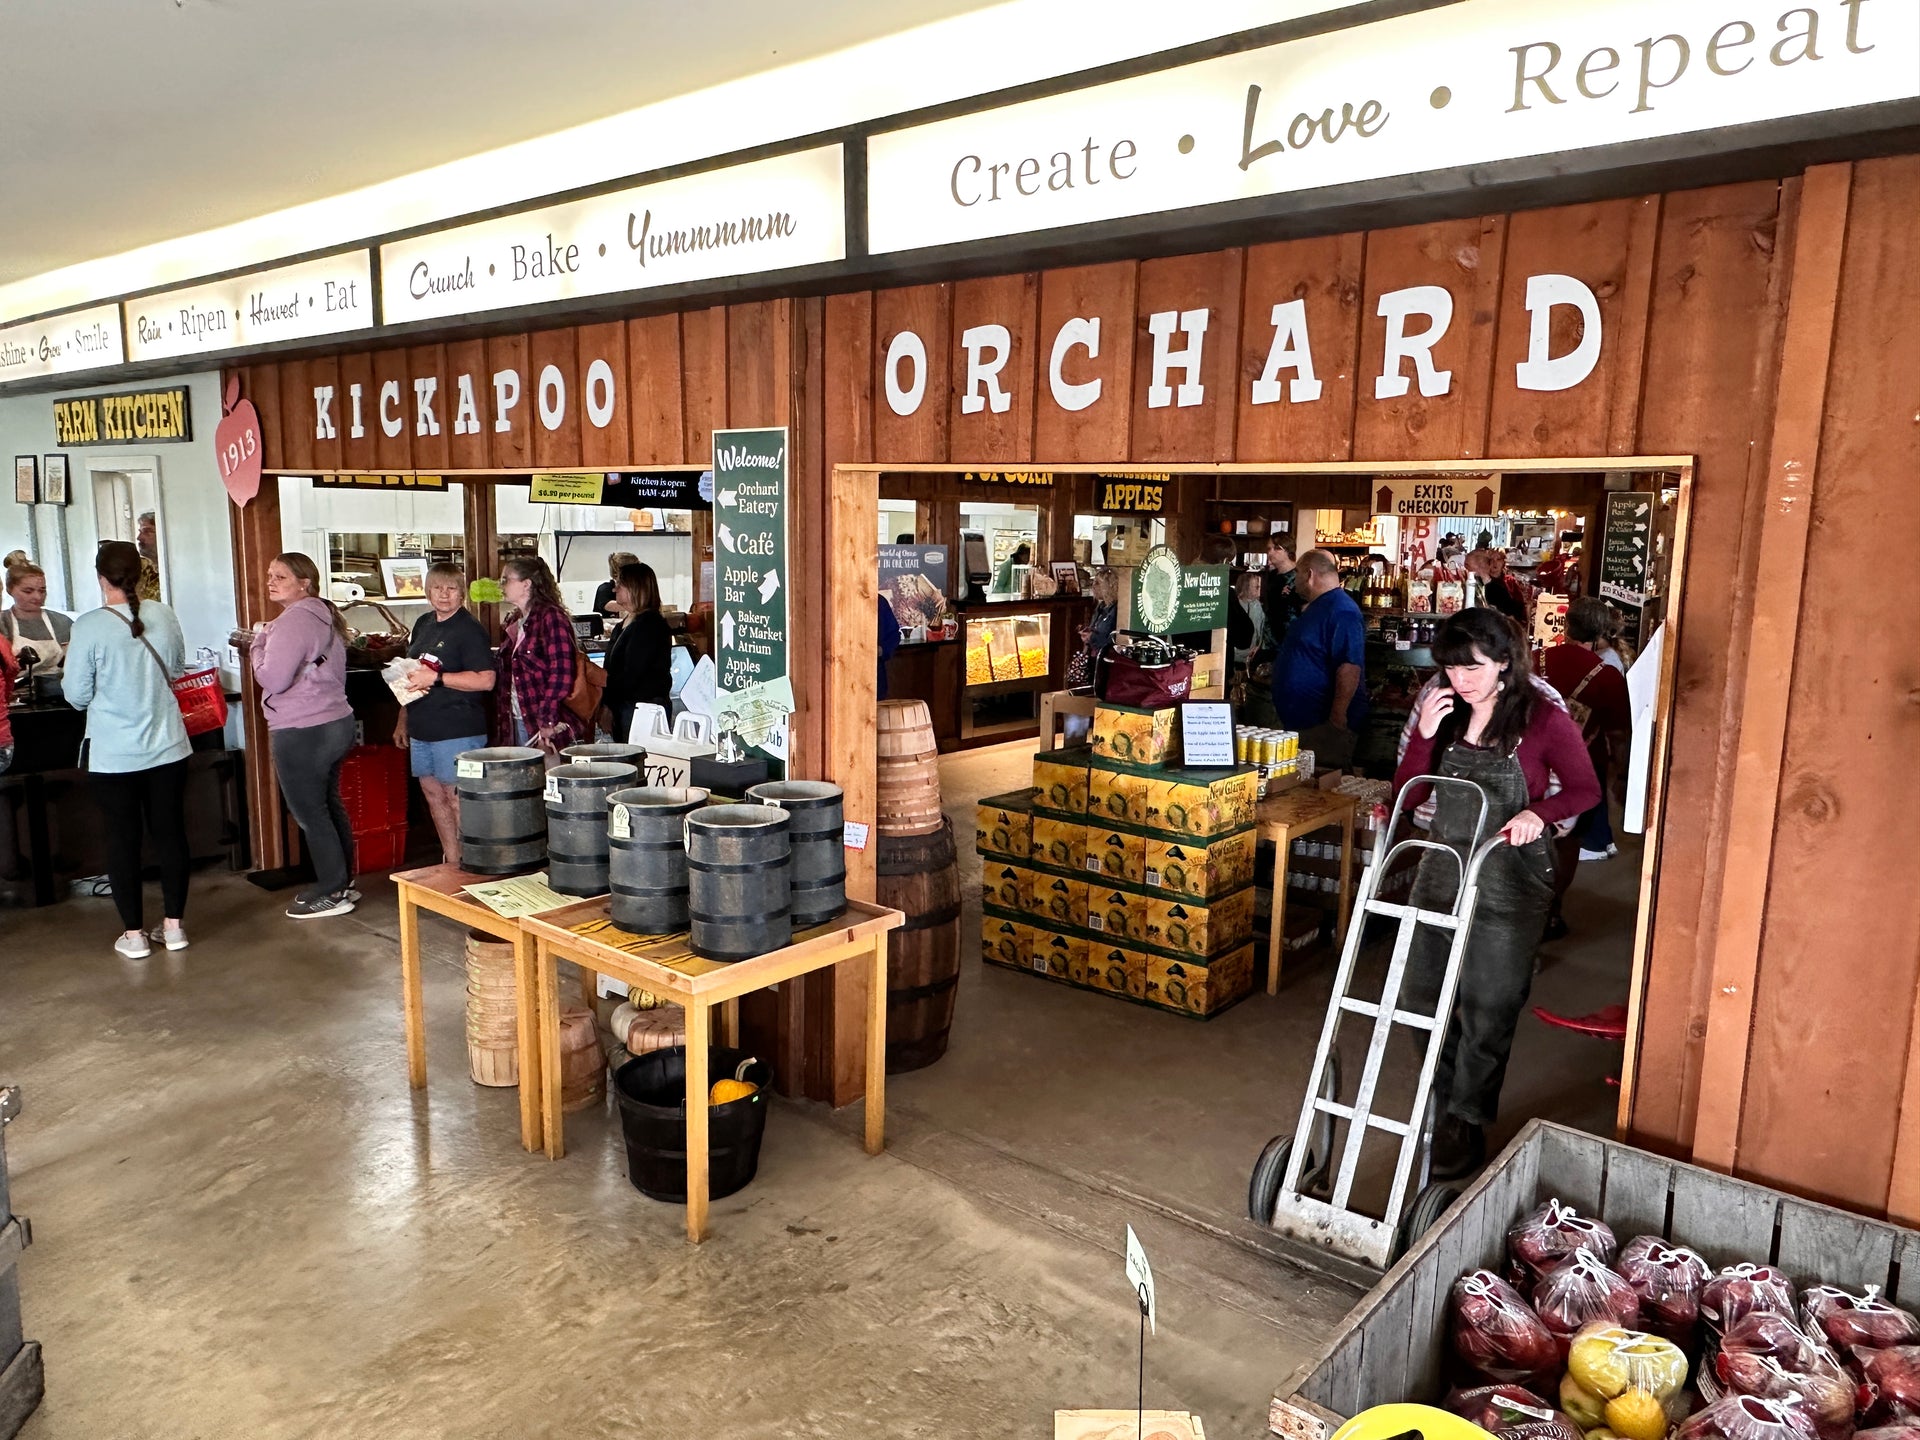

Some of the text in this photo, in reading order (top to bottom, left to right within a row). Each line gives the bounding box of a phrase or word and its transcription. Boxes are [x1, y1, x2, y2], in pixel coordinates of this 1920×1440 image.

[950, 0, 1876, 207] Create Love Repeat
[409, 209, 797, 300] Crunch Bake Yummmmm
[138, 280, 358, 344] Rain Ripen Harvest Eat
[75, 323, 109, 354] Smile
[884, 274, 1602, 416] ORCHARD
[313, 358, 616, 440] KICKAPOO
[54, 390, 184, 442] FARM KITCHEN
[222, 429, 257, 477] 1913
[717, 445, 783, 471] Welcome!
[630, 476, 659, 486] Kitchen
[660, 477, 667, 486] is
[738, 481, 779, 496] Orchard
[1103, 484, 1163, 511] APPLES
[1414, 485, 1453, 498] EXITS
[738, 498, 779, 518] Eatery
[1398, 500, 1469, 515] CHECKOUT
[736, 532, 775, 555] Café
[724, 565, 758, 586] Apple
[1184, 572, 1221, 588] New Glarus
[725, 586, 746, 603] Bar
[738, 610, 770, 628] Bakery
[738, 624, 783, 642] & Market
[738, 640, 772, 656] Atrium
[726, 657, 761, 674] Apples
[723, 672, 761, 690] & Cide
